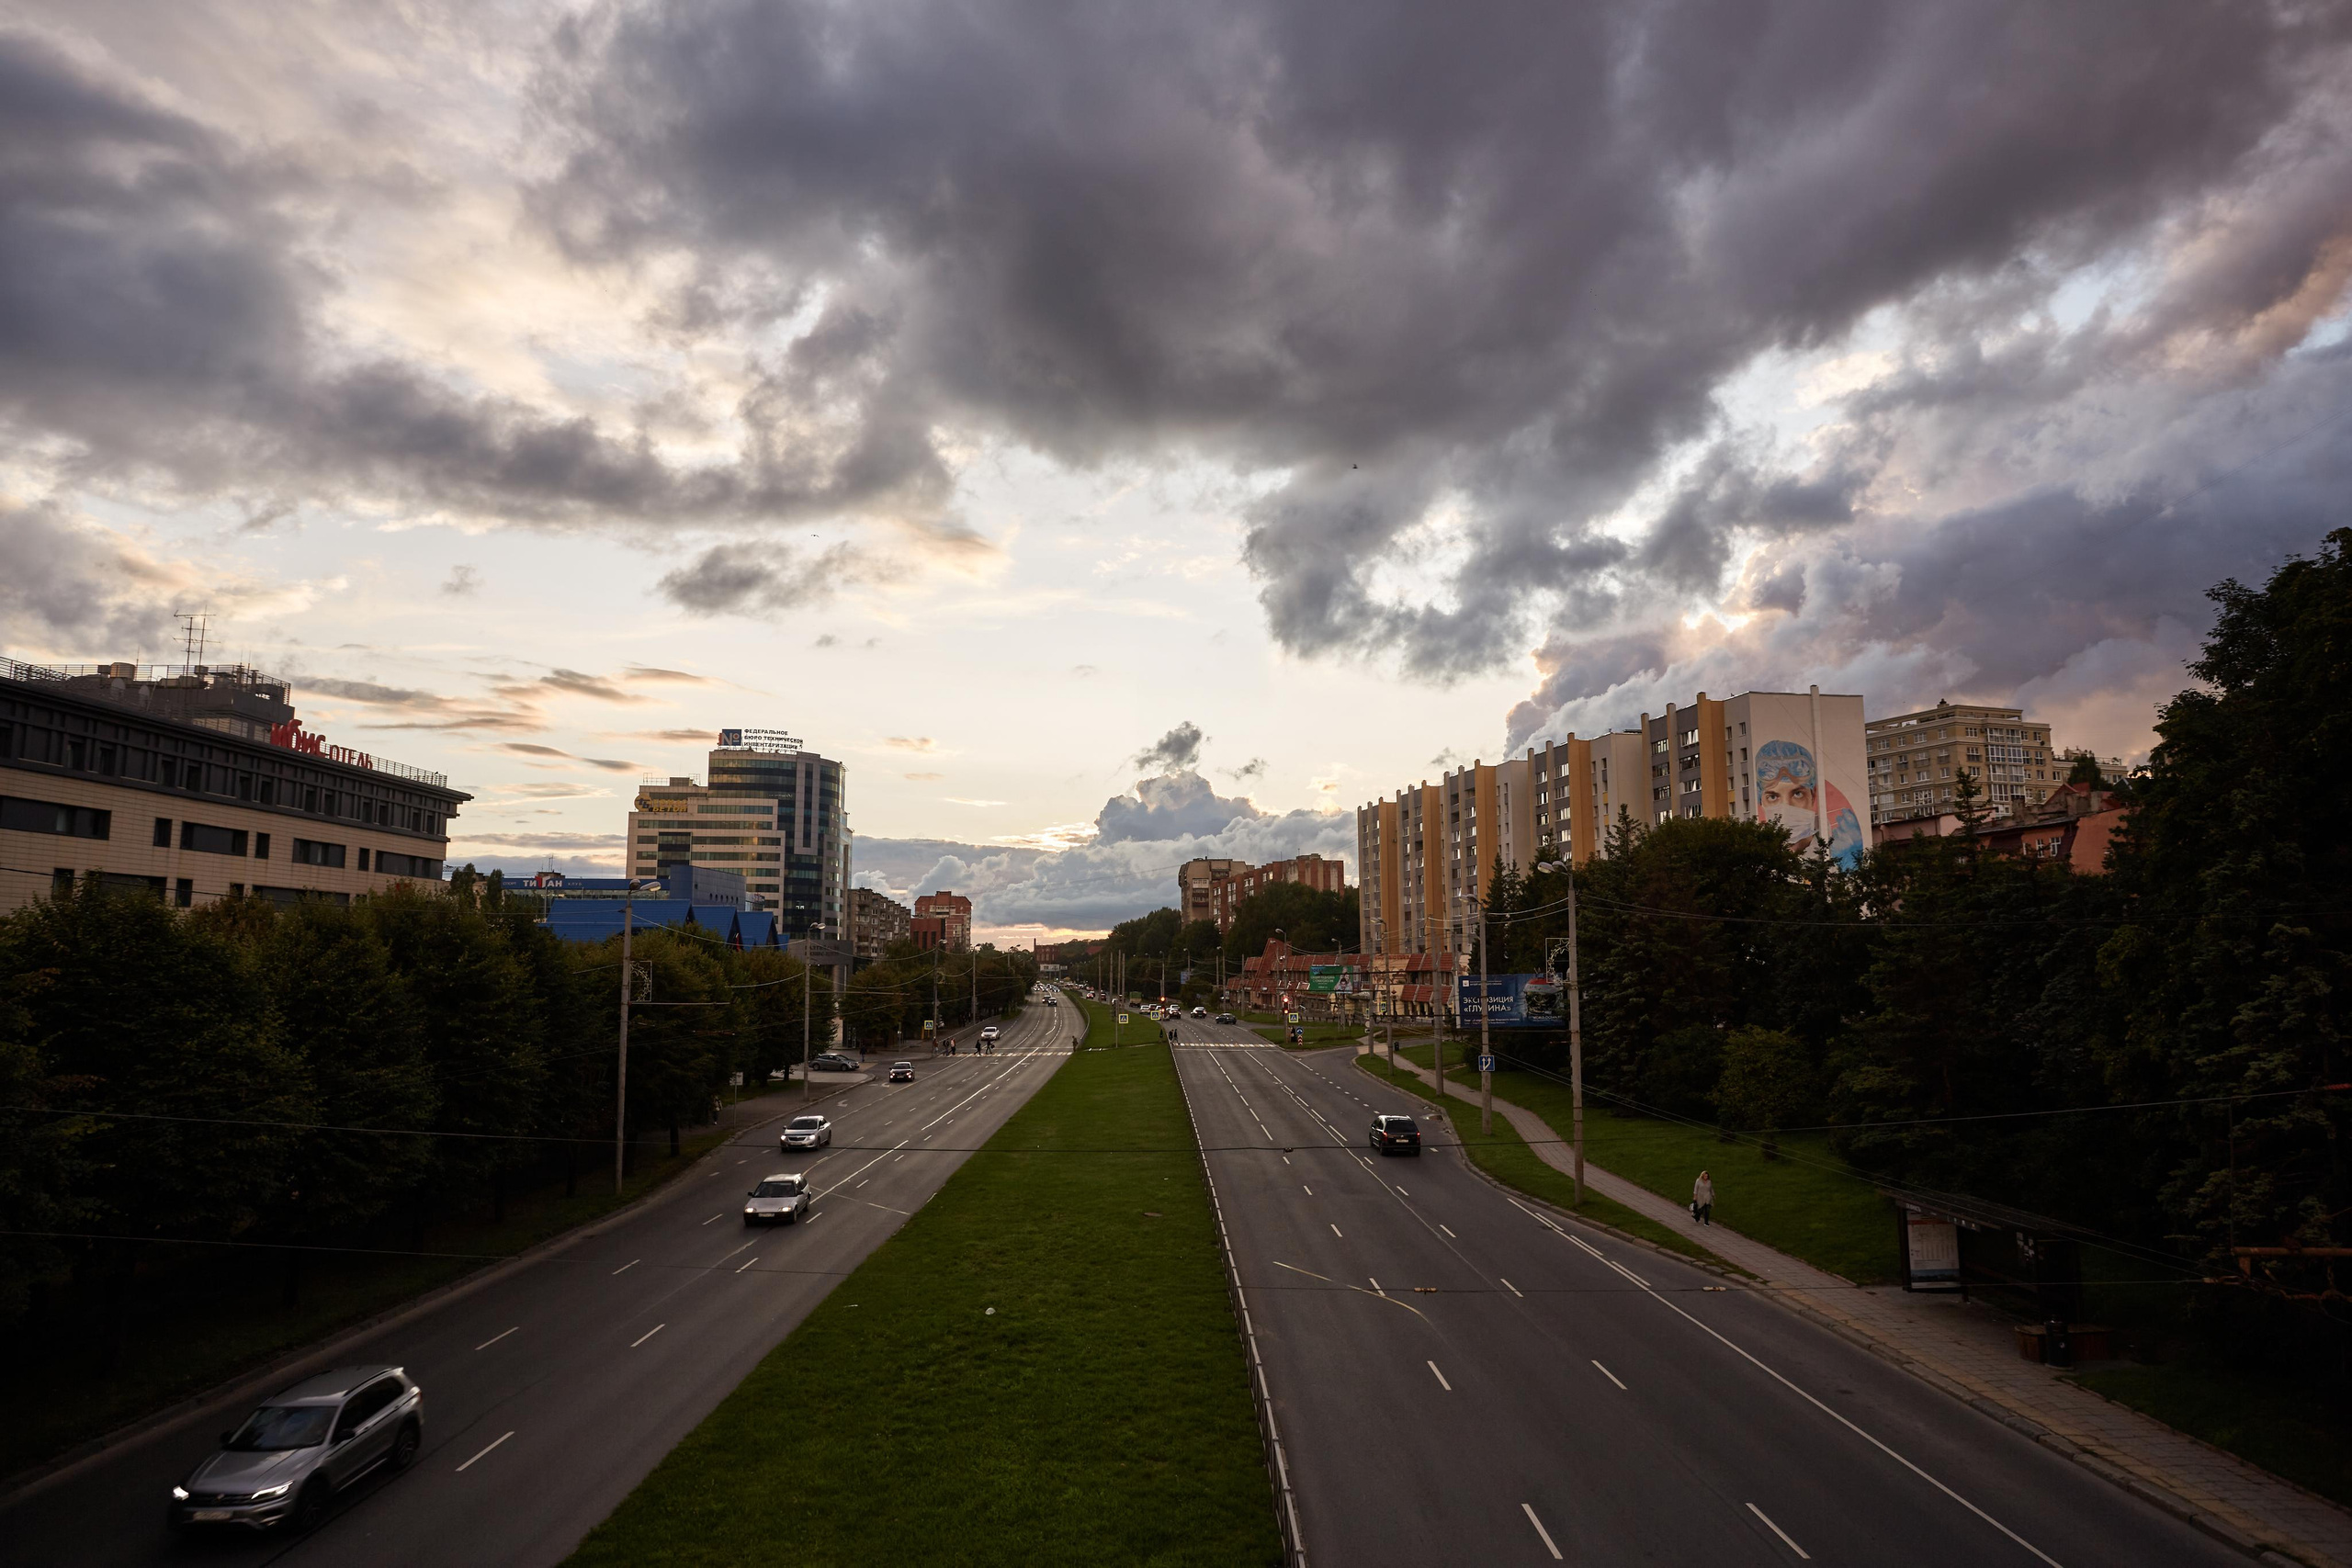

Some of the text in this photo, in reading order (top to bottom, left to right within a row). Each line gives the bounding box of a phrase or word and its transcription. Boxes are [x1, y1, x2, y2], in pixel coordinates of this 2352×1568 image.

[763, 736, 804, 744] ТЕХНИЧЕСКОЙ
[523, 875, 562, 889] ТИТАН
[1464, 1004, 1512, 1012] «ГЛУИНА»
